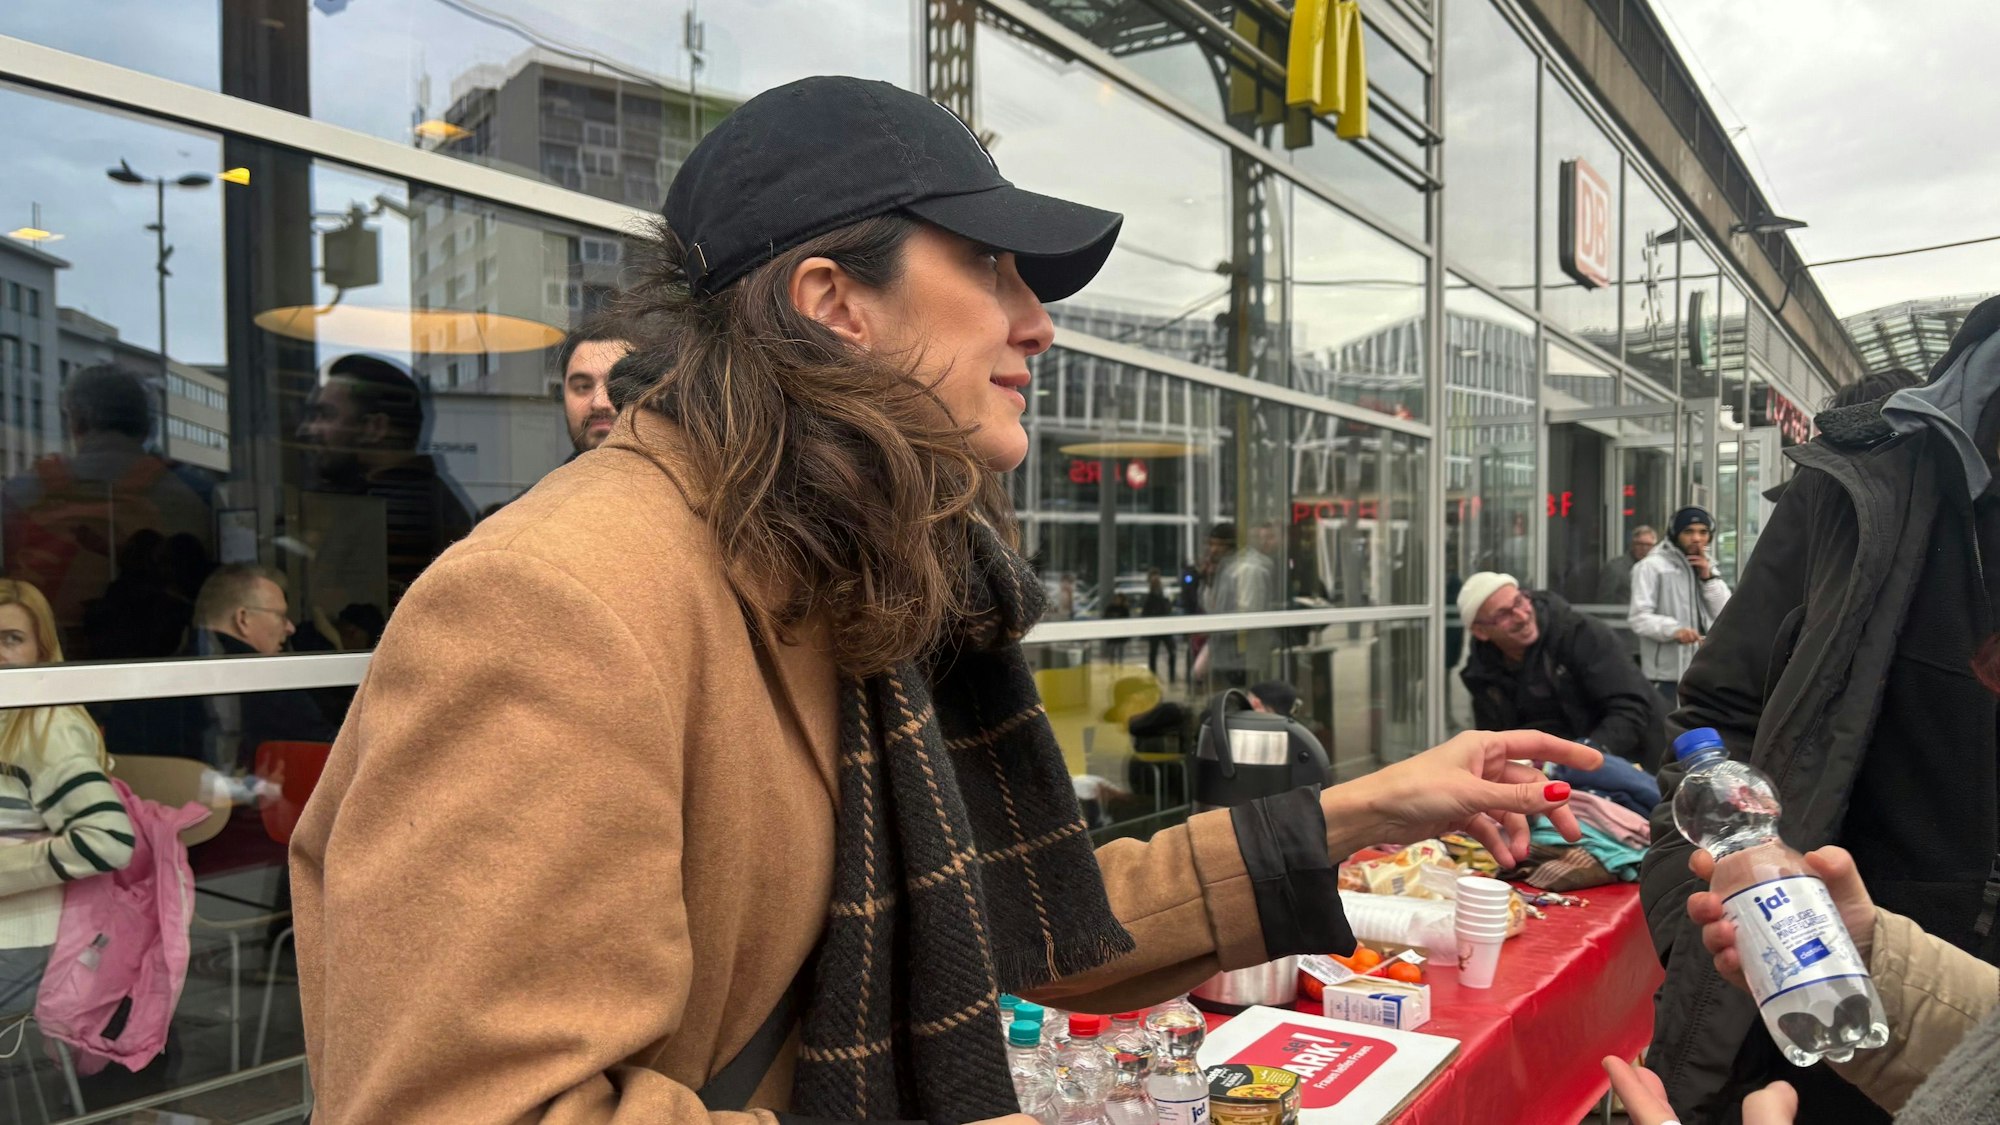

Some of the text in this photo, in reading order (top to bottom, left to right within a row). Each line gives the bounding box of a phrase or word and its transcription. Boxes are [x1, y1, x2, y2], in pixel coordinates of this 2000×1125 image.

[1582, 179, 1606, 268] DB
[1754, 887, 1790, 922] ja!
[1280, 1032, 1352, 1083] ARK!
[1192, 1102, 1206, 1123] ja!
